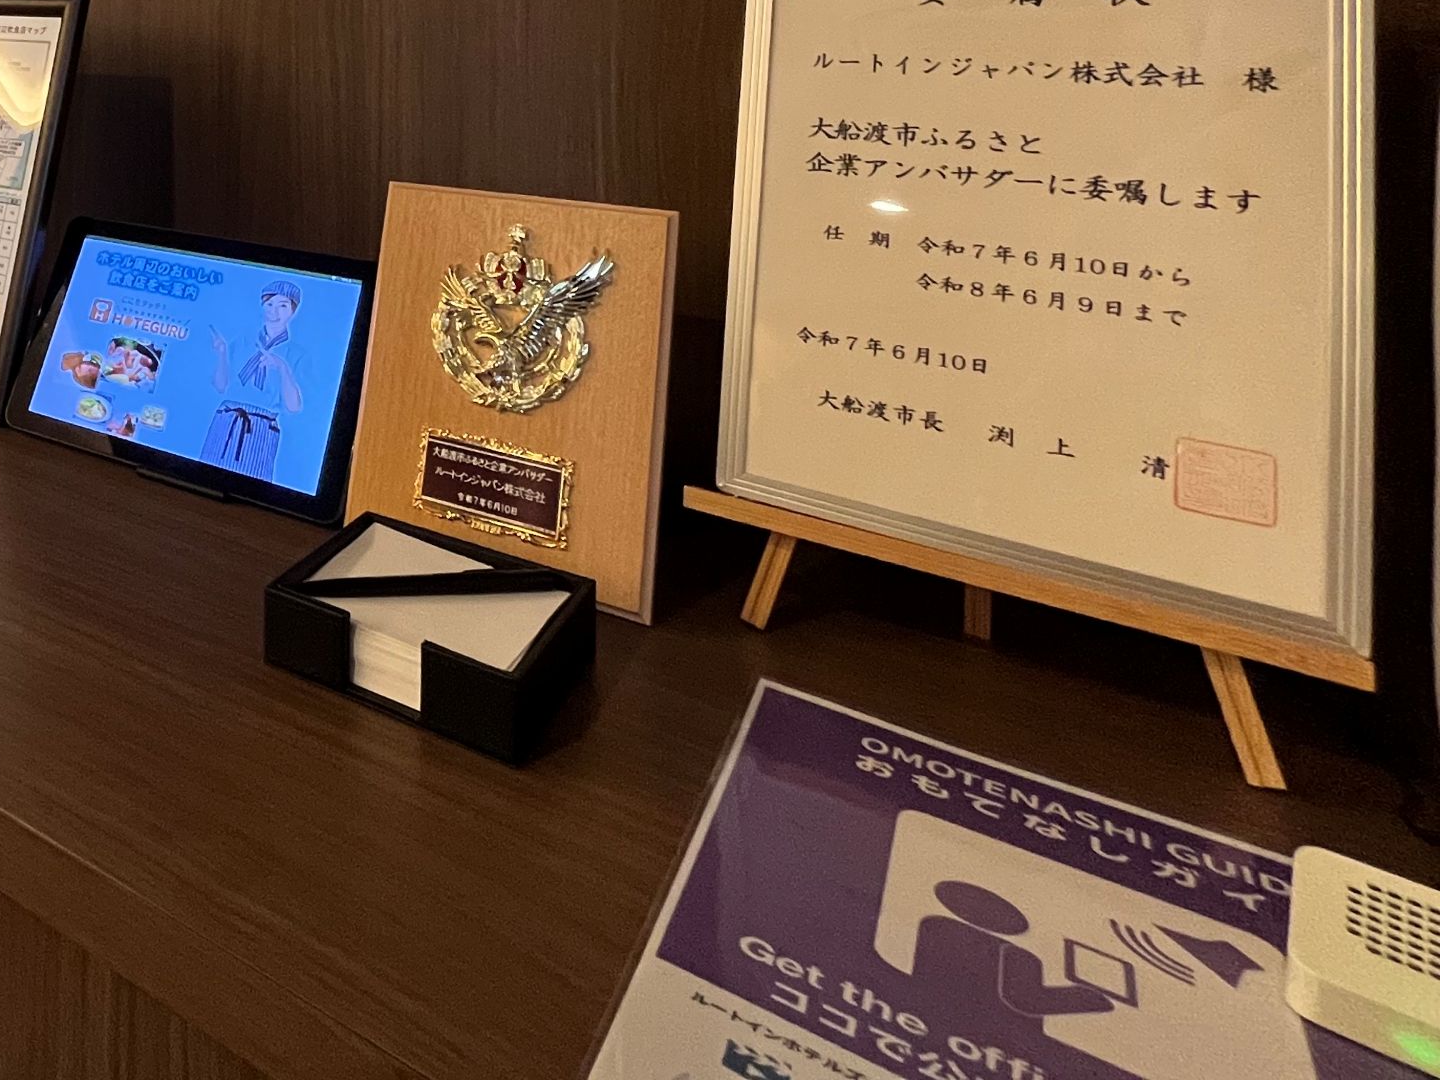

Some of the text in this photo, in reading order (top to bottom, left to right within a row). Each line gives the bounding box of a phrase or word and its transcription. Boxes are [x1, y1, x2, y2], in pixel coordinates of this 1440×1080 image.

[813, 52, 1279, 93] ルートインジャパン株式会社 様
[809, 117, 1041, 155] 大船渡市ふるさと
[806, 152, 1262, 214] 企業アンバサダーに委嘱します
[823, 224, 890, 249] 任期
[97, 251, 223, 286] ホテル周辺のおいしい
[108, 271, 200, 301] 飲食店をご案内
[796, 326, 988, 374] 令和7年6月10日
[818, 390, 944, 432] 大船渡市長
[434, 466, 546, 504] ルートインジャパン株式会社
[861, 737, 1153, 850] OMOTENASHI
[739, 936, 825, 990] Get
[840, 981, 928, 1036] the
